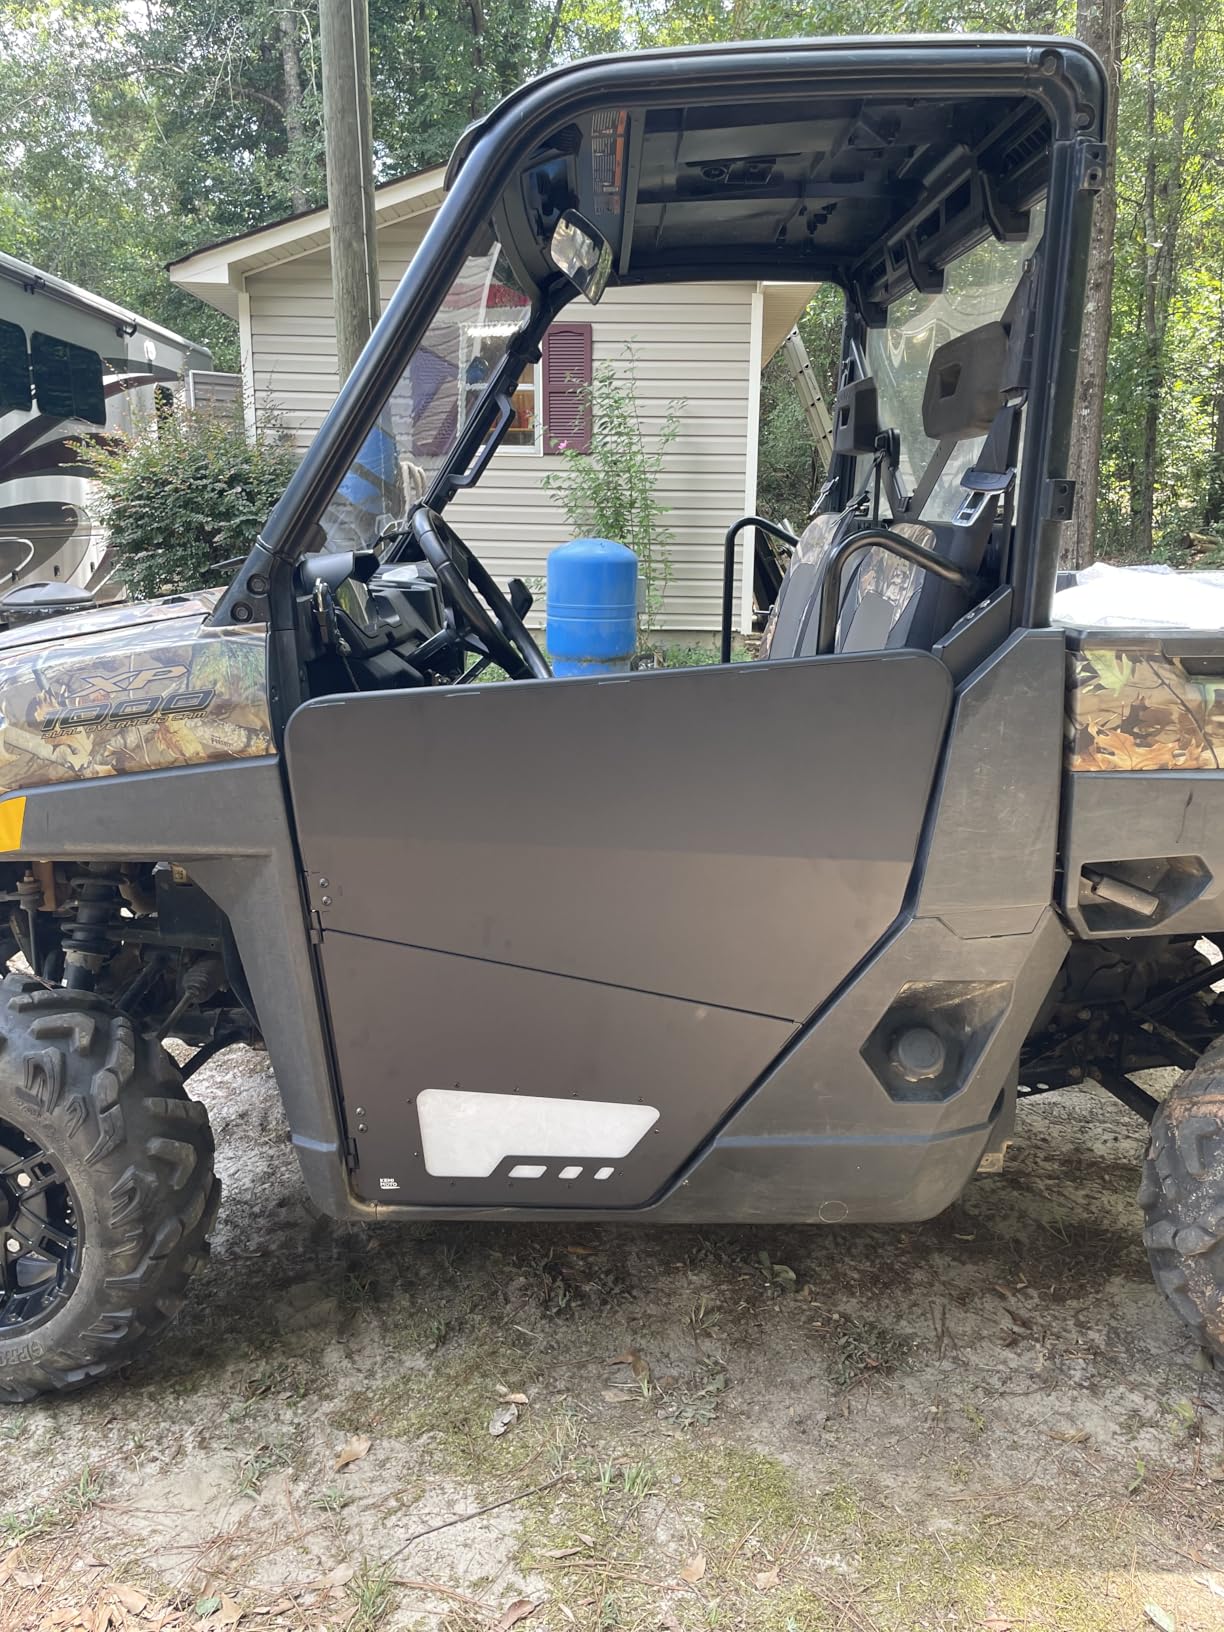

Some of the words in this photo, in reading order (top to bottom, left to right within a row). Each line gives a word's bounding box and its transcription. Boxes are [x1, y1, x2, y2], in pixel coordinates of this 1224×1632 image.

[69, 664, 190, 698] XP
[41, 688, 216, 731] 1000
[41, 727, 82, 739] DUAL
[85, 715, 170, 733] OVERHEAD
[171, 710, 209, 721] CAM
